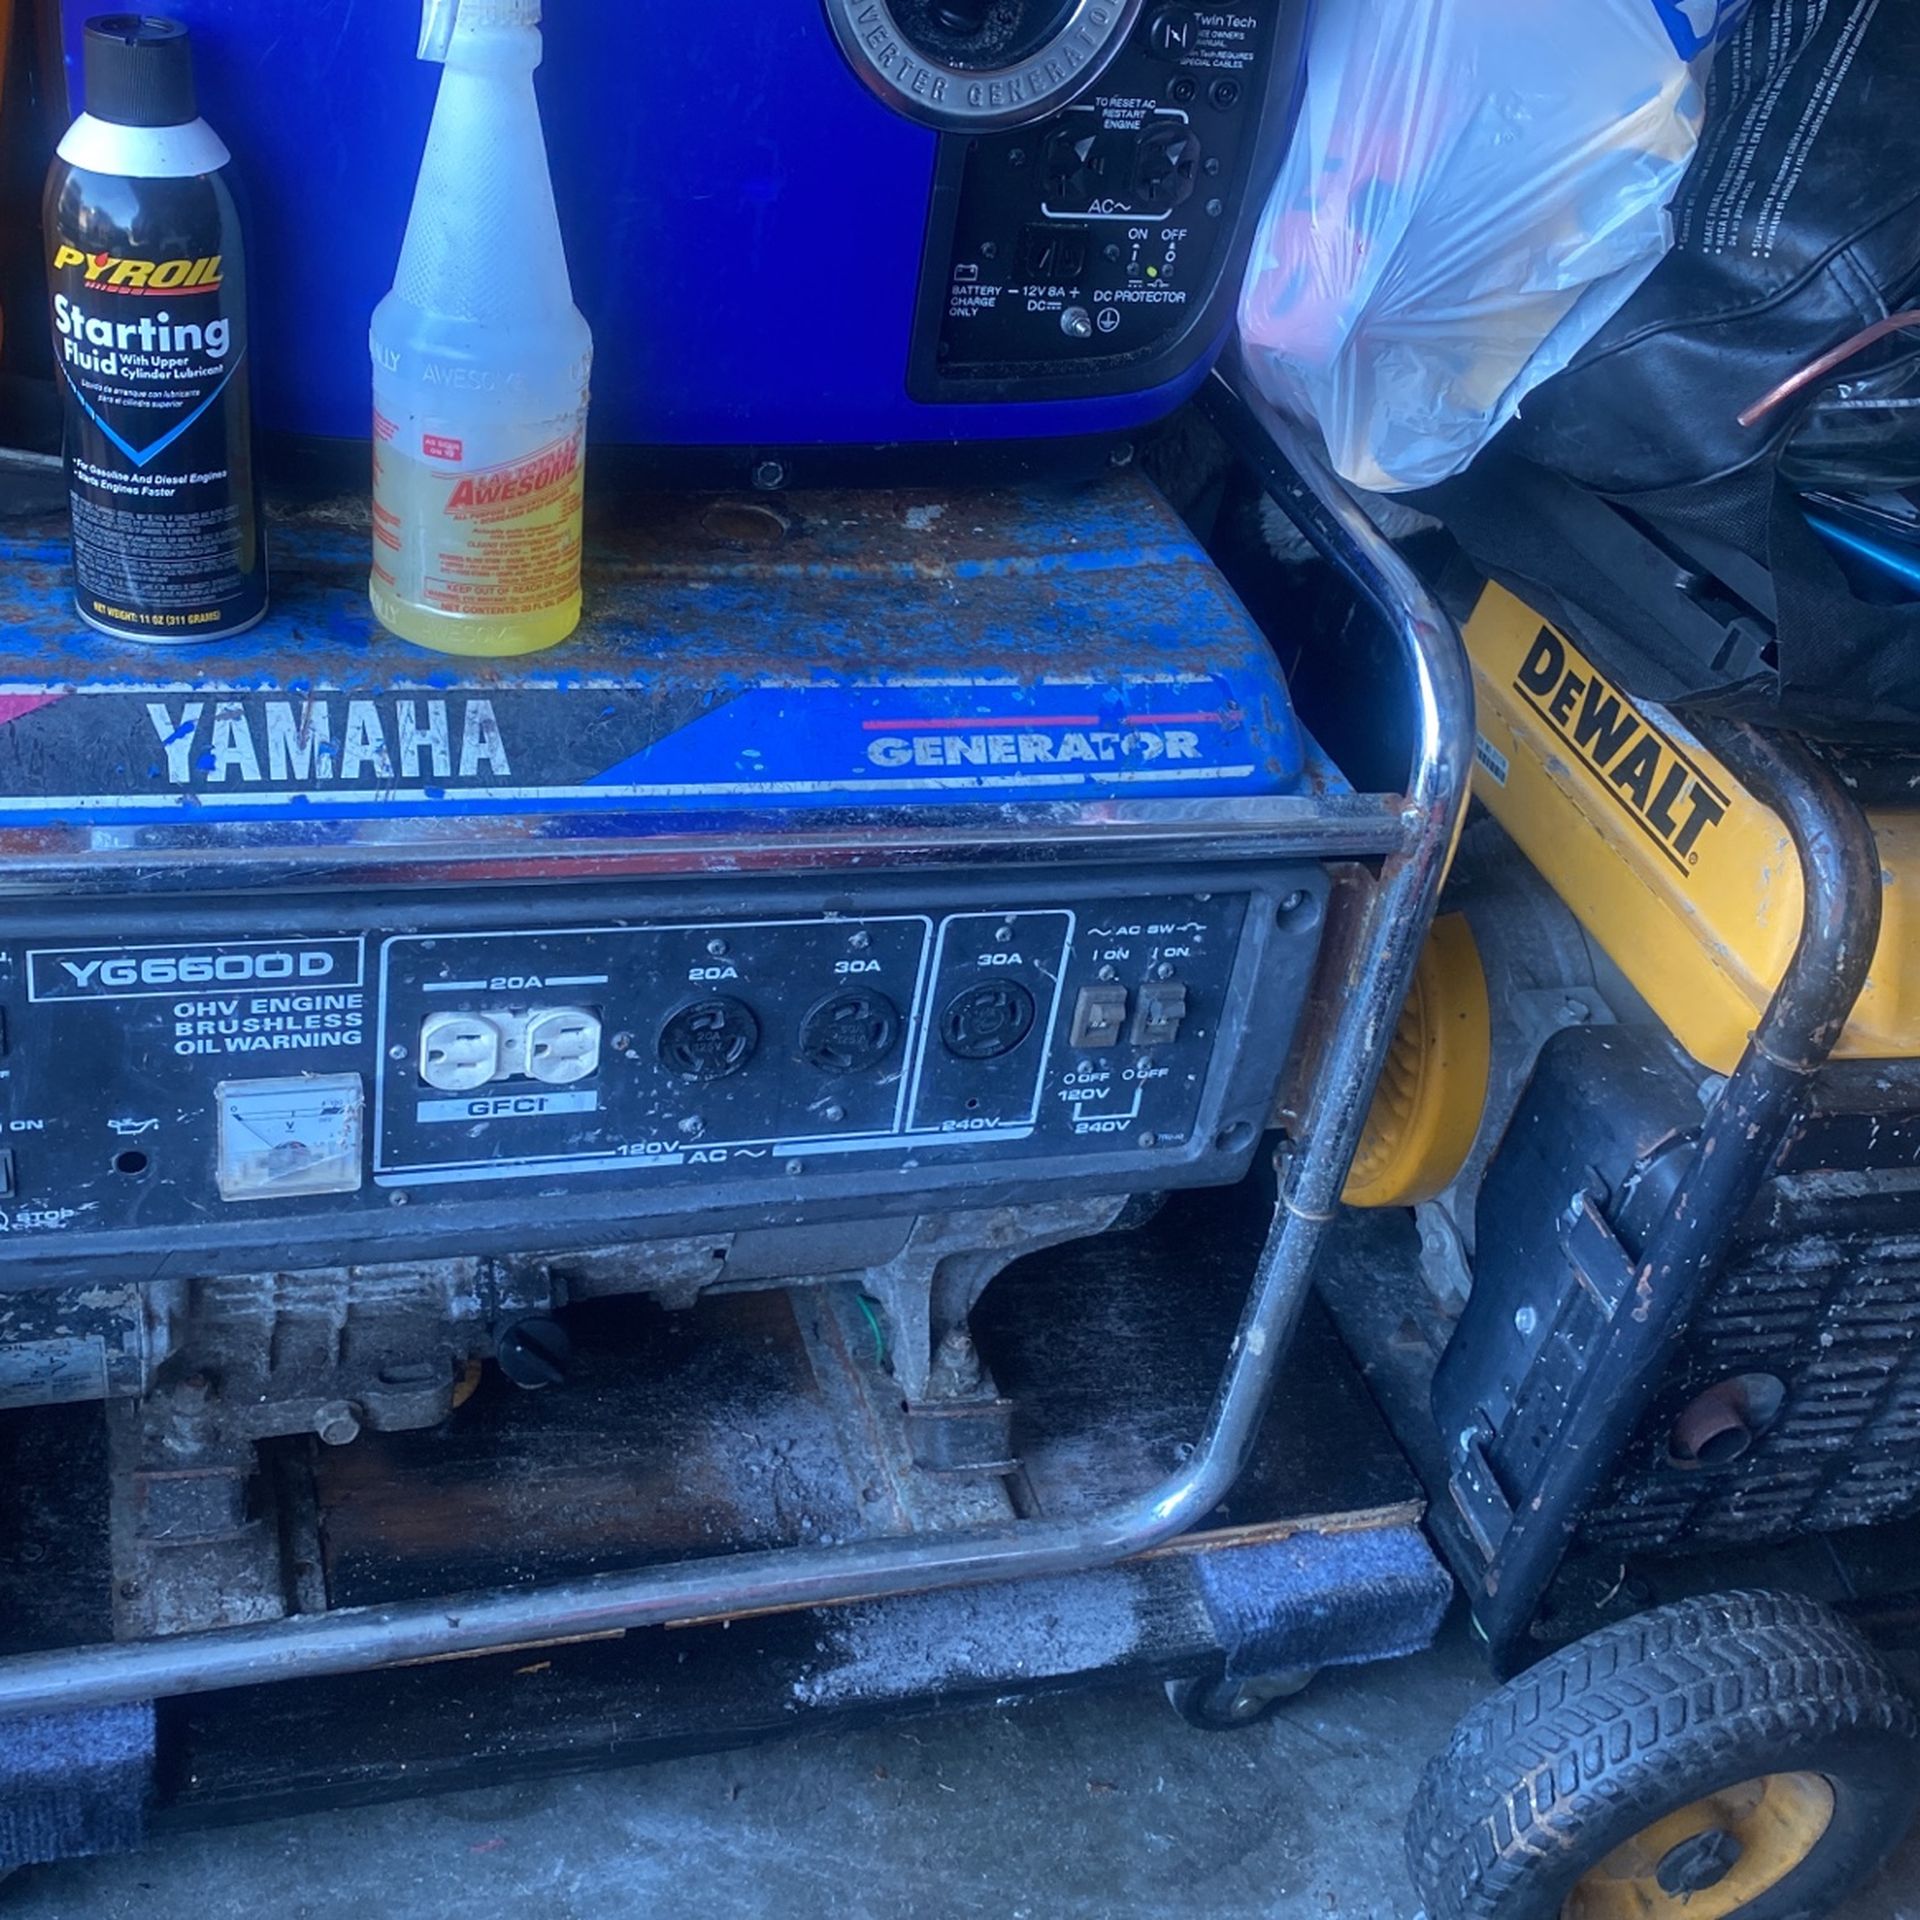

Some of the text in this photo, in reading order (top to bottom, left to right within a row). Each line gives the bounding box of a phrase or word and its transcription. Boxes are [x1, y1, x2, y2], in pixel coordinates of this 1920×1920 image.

[1194, 12, 1257, 28] Twin Tech
[852, 0, 1119, 107] VERTER GENERATO
[1095, 97, 1156, 109] TO RESET AC
[1102, 109, 1146, 118] RESTART
[1104, 119, 1141, 130] ENGINE
[1754, 118, 1767, 133] EL
[1750, 131, 1761, 145] EN
[1088, 199, 1113, 213] AC
[1720, 205, 1731, 219] LA
[1128, 228, 1187, 241] ON OFF
[1703, 218, 1715, 247] MAKE
[1715, 217, 1727, 247] HAGA
[1751, 224, 1765, 251] Start
[54, 245, 223, 288] PYROIL
[951, 286, 1001, 296] BATTERY
[1023, 286, 1065, 297] 12V 8A
[1094, 291, 1186, 303] DC PROTECTOR
[950, 297, 996, 307] CHARGE
[1027, 300, 1046, 311] DC
[949, 308, 978, 316] ONLY
[54, 293, 230, 358] Starting
[64, 337, 189, 376] Fluid With Upper
[120, 364, 224, 380] Cylinder Lubricant
[151, 400, 184, 409] superior
[76, 458, 227, 484] For Gasoline And Diesel Engines
[100, 479, 139, 495] Engines
[141, 486, 176, 497] Faster
[447, 456, 577, 508] AWESOME
[447, 584, 472, 593] KEEP
[474, 587, 495, 595] OUT
[497, 587, 509, 595] OF
[93, 601, 105, 613] NET
[107, 604, 139, 622] WEIGHT:
[139, 614, 151, 624] 11
[152, 614, 164, 625] OZ
[165, 613, 186, 626] (311
[146, 699, 511, 784] YAMAHA
[867, 730, 1202, 768] GENERATOR
[1517, 625, 1726, 859] DEWALT
[1115, 923, 1175, 935] AC SW
[977, 953, 1023, 966] 30A
[1104, 949, 1130, 960] ON
[1164, 947, 1190, 957] ON
[61, 951, 335, 988] YG6600D
[688, 966, 738, 981] 20A
[834, 959, 881, 973] 30A
[489, 976, 543, 991] 20A
[173, 993, 363, 1018] OHV ENGINE
[175, 1012, 363, 1037] BRUSHLESS
[174, 1030, 362, 1055] OIL WARNING
[1078, 1072, 1110, 1082] OFF
[1137, 1067, 1169, 1079] OFF
[1058, 1087, 1111, 1101] 120V
[467, 1097, 546, 1116] GFCI
[10, 1120, 44, 1132] ON
[941, 1117, 1000, 1132] 240V
[1074, 1120, 1131, 1134] 240V
[616, 1140, 679, 1156] 120V
[688, 1149, 727, 1165] AC
